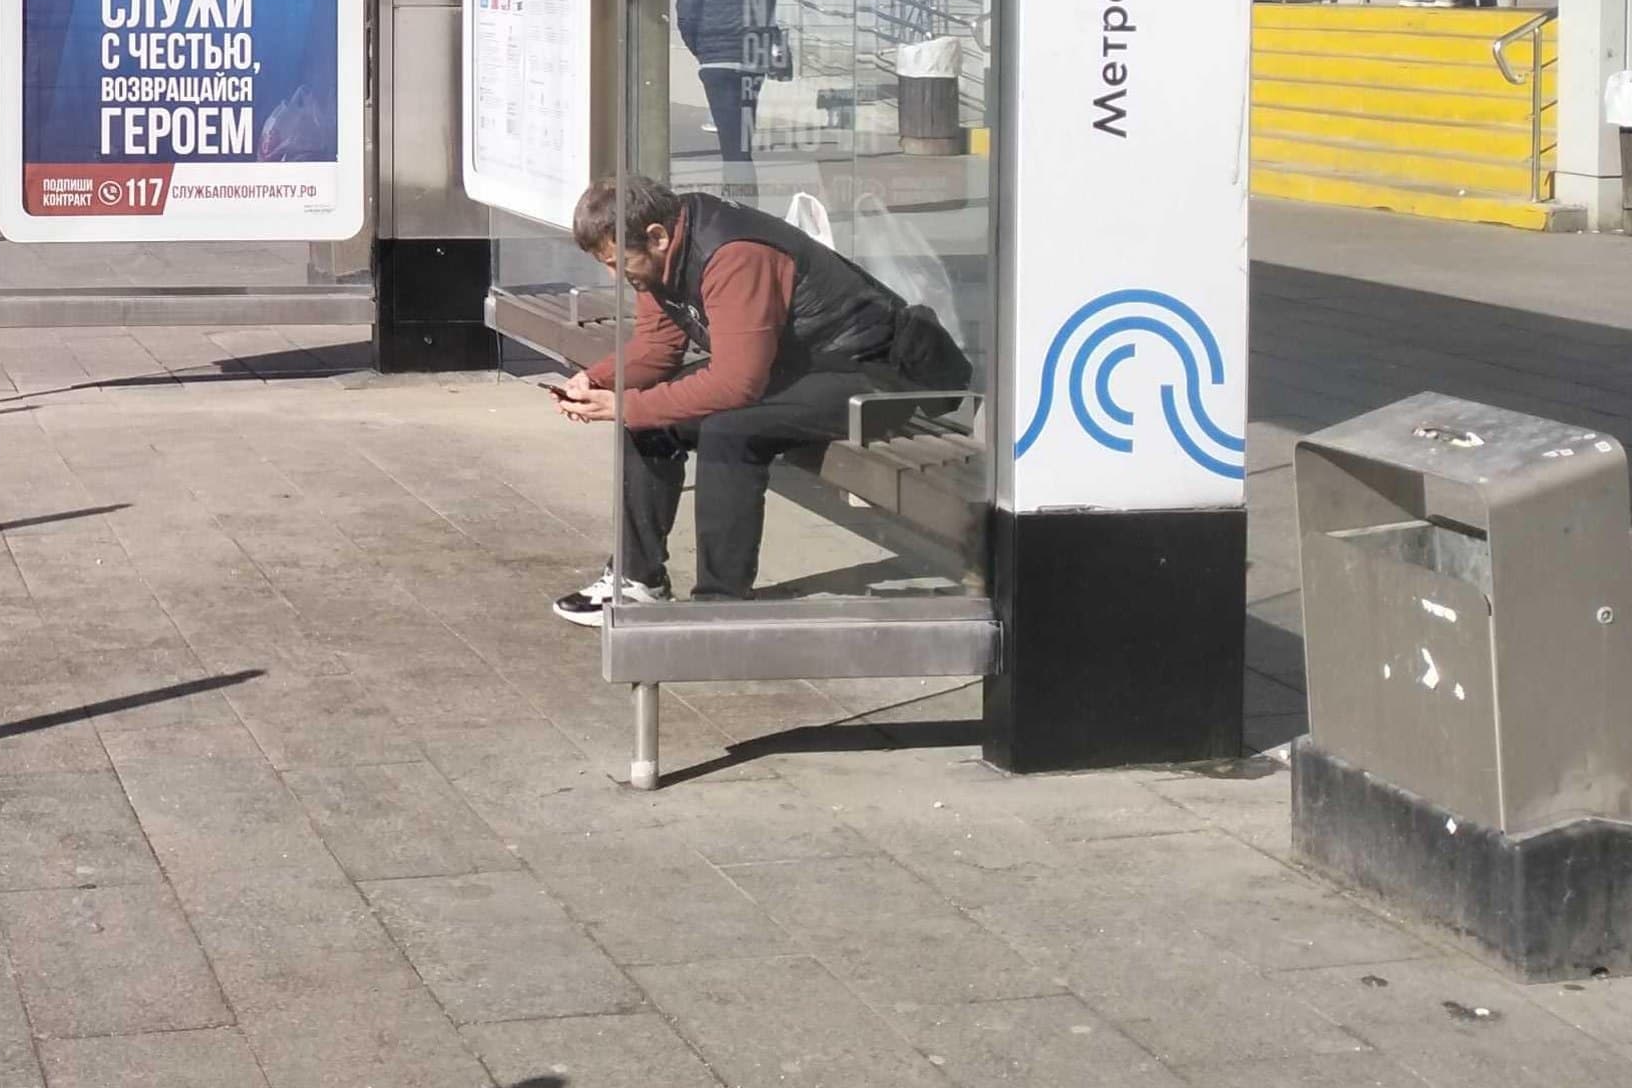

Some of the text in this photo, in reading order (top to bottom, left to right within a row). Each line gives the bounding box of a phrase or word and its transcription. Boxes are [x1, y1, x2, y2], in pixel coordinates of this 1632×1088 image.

[101, 32, 261, 74] С ЧЕСТЬЮ,
[101, 72, 253, 104] ВОЗВРАЩАЙСЯ
[100, 107, 253, 155] ГЕРОЕМ
[43, 178, 93, 193] ПОДПИШИ
[43, 192, 93, 207] КОНТРАКТ
[126, 178, 164, 207] 117
[172, 184, 318, 198] СЛУЖБАПОКОНТРАКТУ.РФ
